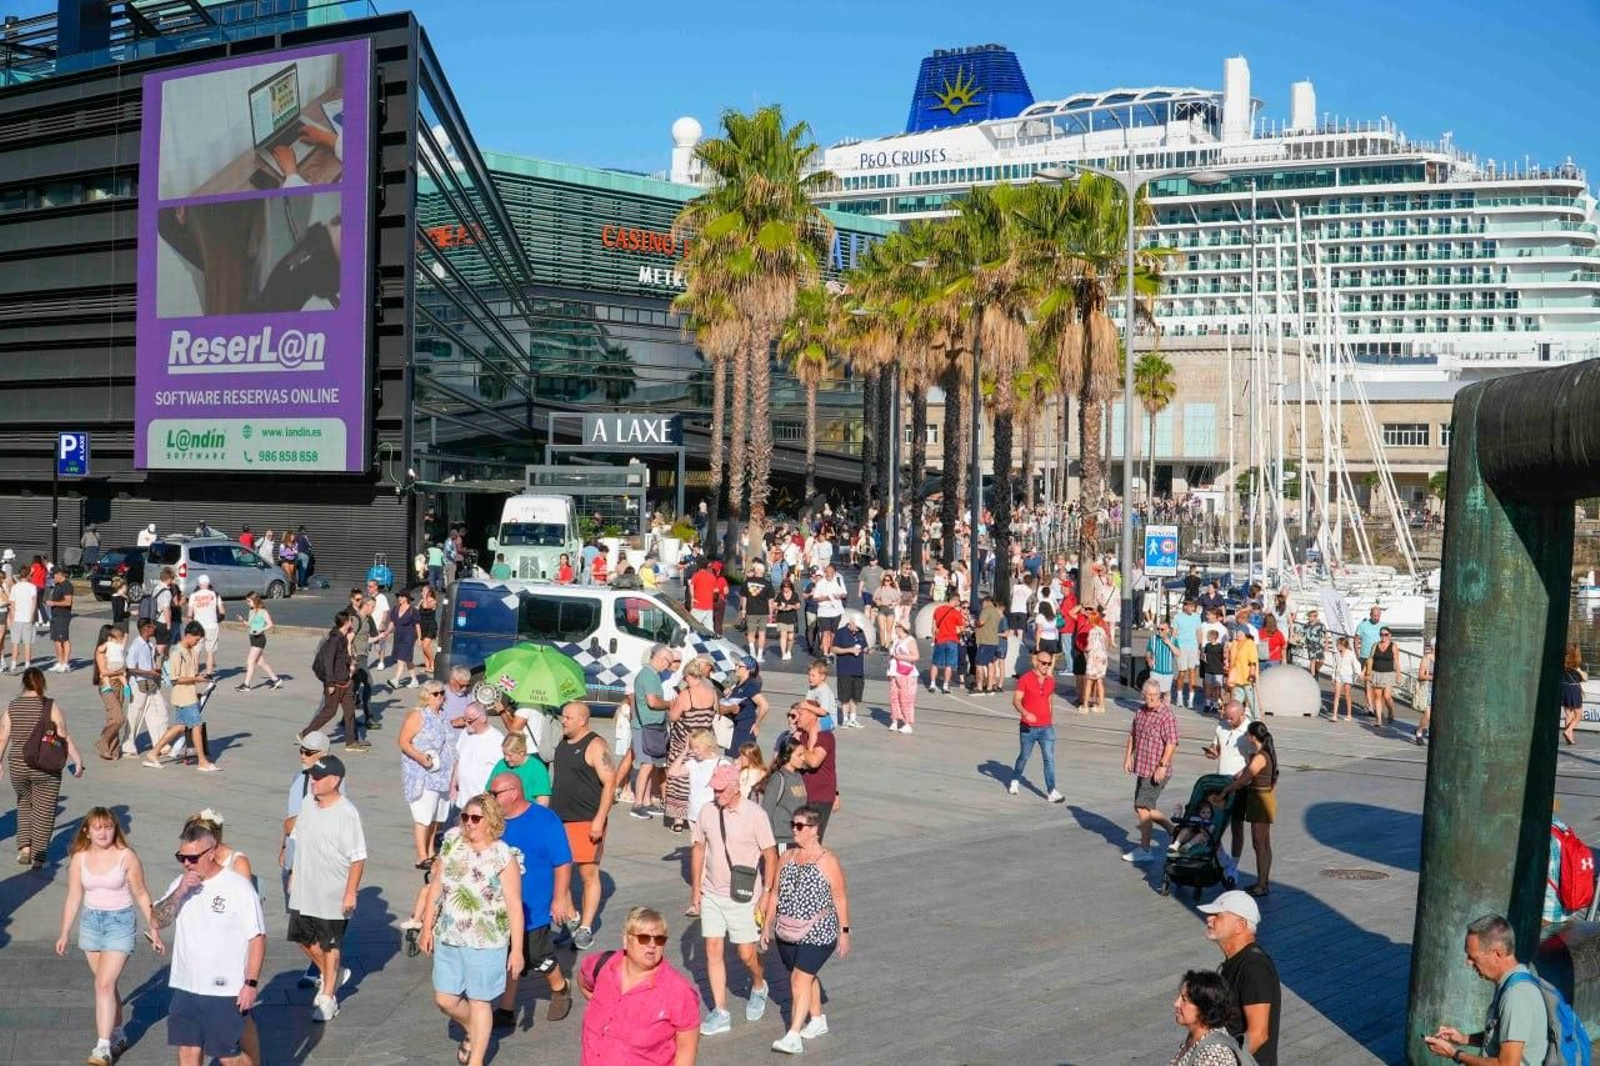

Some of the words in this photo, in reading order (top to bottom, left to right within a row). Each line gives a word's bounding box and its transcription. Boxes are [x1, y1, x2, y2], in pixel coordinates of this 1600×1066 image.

[860, 152, 887, 168] P&O
[892, 148, 946, 166] CRUISES
[602, 224, 676, 256] CASINO
[168, 326, 326, 367] ReserL@n
[155, 390, 221, 406] SOFTWARE
[223, 389, 288, 404] RESERVAS
[291, 387, 340, 404] ONLINE
[592, 418, 607, 442] A
[616, 418, 674, 443] LAXE
[60, 434, 77, 460] P
[166, 452, 226, 461] SOFTWARE
[258, 450, 277, 462] 986
[279, 450, 298, 462] 858
[299, 450, 318, 462] 858
